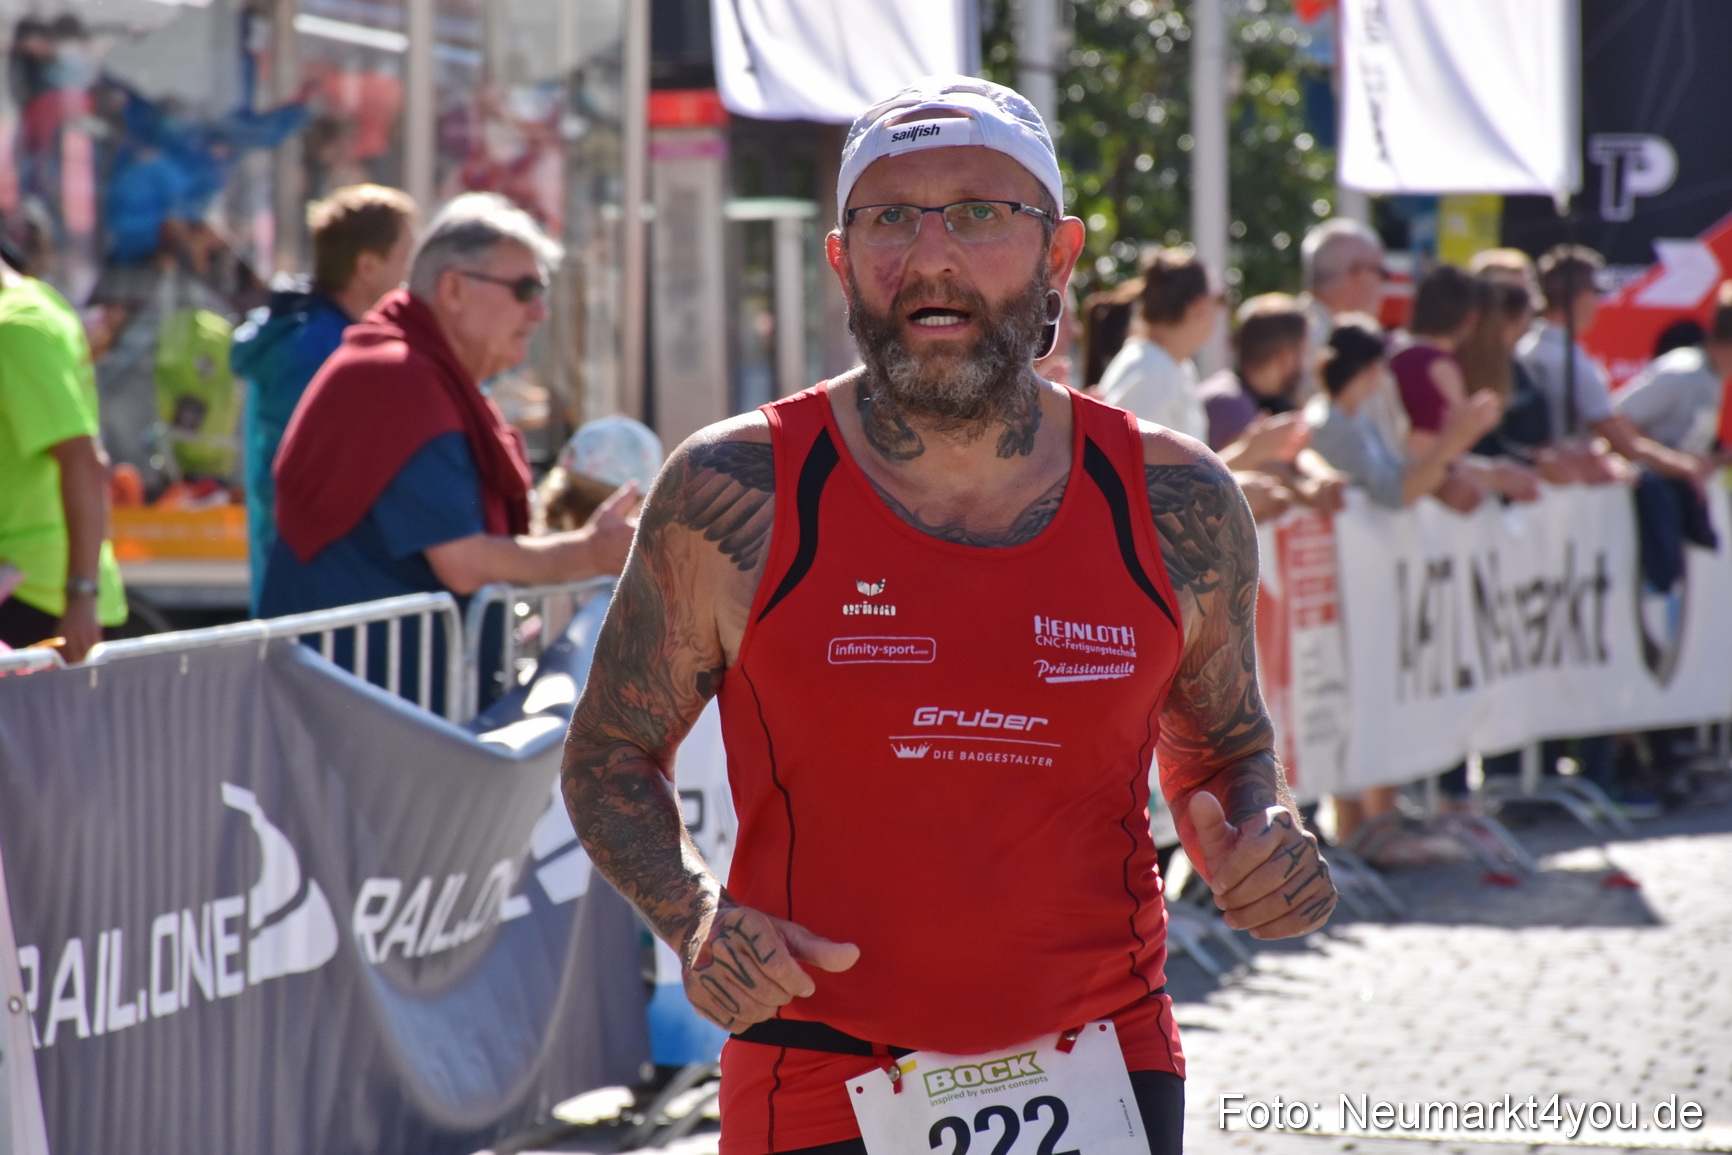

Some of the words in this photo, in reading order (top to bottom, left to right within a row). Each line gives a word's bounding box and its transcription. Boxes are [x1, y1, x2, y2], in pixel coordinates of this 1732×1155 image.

[891, 124, 941, 142] sailfish
[842, 601, 896, 616] erima
[1034, 615, 1135, 647] HEINLOTH
[1035, 635, 1137, 658] CNC-Fertigungstechnik
[1033, 660, 1135, 678] Präzisionsteile
[913, 706, 1049, 731] Gruber
[933, 750, 954, 760] DIE
[959, 751, 1053, 767] BADGESTALTER
[923, 1051, 1045, 1098] BOCK
[929, 1090, 966, 1108] inspired
[967, 1087, 978, 1098] by
[980, 1083, 1006, 1096] smart
[1008, 1075, 1049, 1090] concepts
[928, 1095, 1081, 1155] 222
